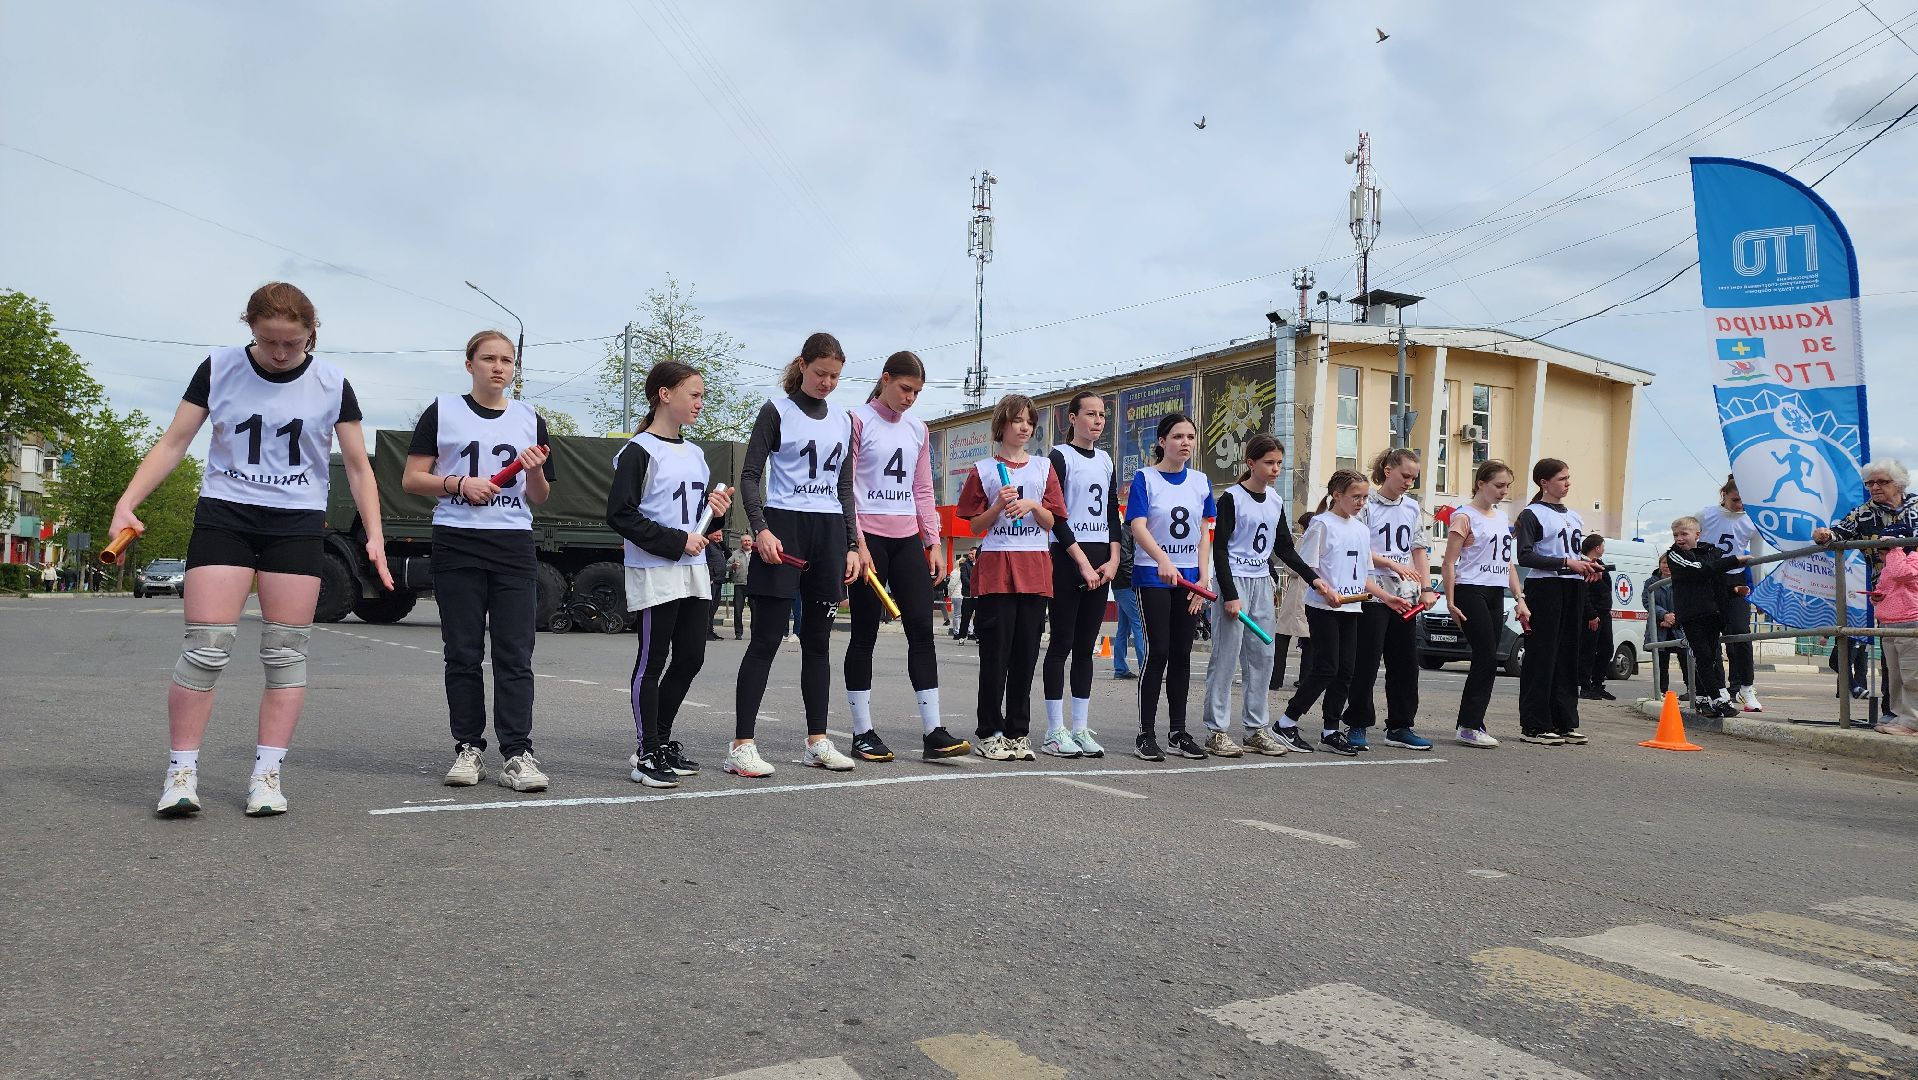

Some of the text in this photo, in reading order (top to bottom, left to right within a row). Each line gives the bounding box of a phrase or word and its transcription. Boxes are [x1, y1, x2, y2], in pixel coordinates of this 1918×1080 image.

[1135, 397, 1184, 420] ПЕРЕСТРОЙКА
[235, 413, 304, 466] 11
[1215, 433, 1235, 469] 9
[460, 440, 518, 488] 13
[800, 440, 842, 479] 14
[884, 448, 907, 484] 4
[673, 481, 705, 524] 17
[868, 490, 912, 502] КАШИР
[1088, 483, 1103, 517] 3
[1169, 506, 1191, 540] 8
[1253, 523, 1269, 554] 6
[1378, 523, 1411, 552] 10
[1489, 534, 1512, 562] 18
[1558, 528, 1582, 555] 16
[1718, 534, 1735, 554] 5
[1347, 551, 1358, 580] 7
